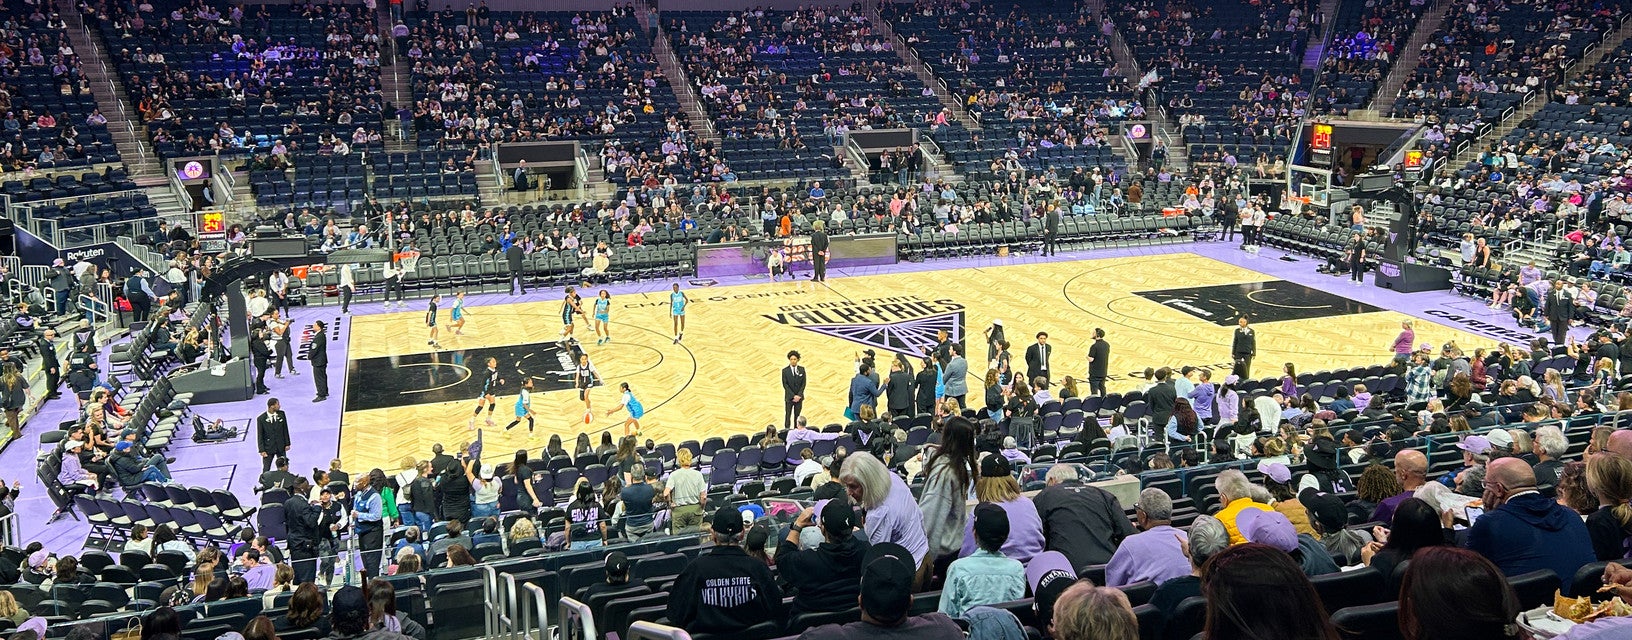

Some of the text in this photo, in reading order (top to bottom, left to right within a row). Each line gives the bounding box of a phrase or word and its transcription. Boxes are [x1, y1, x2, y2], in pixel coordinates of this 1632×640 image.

[1315, 133, 1330, 147] 24
[204, 221, 218, 232] 24
[67, 247, 105, 261] Rakuten
[733, 290, 808, 299] CENTER
[778, 295, 922, 312] GOLDEN STATE
[761, 299, 966, 324] VALKYRIES
[1331, 479, 1347, 494] 15
[705, 576, 751, 588] GOLDEN STATE
[701, 585, 758, 608] VALKYRIES
